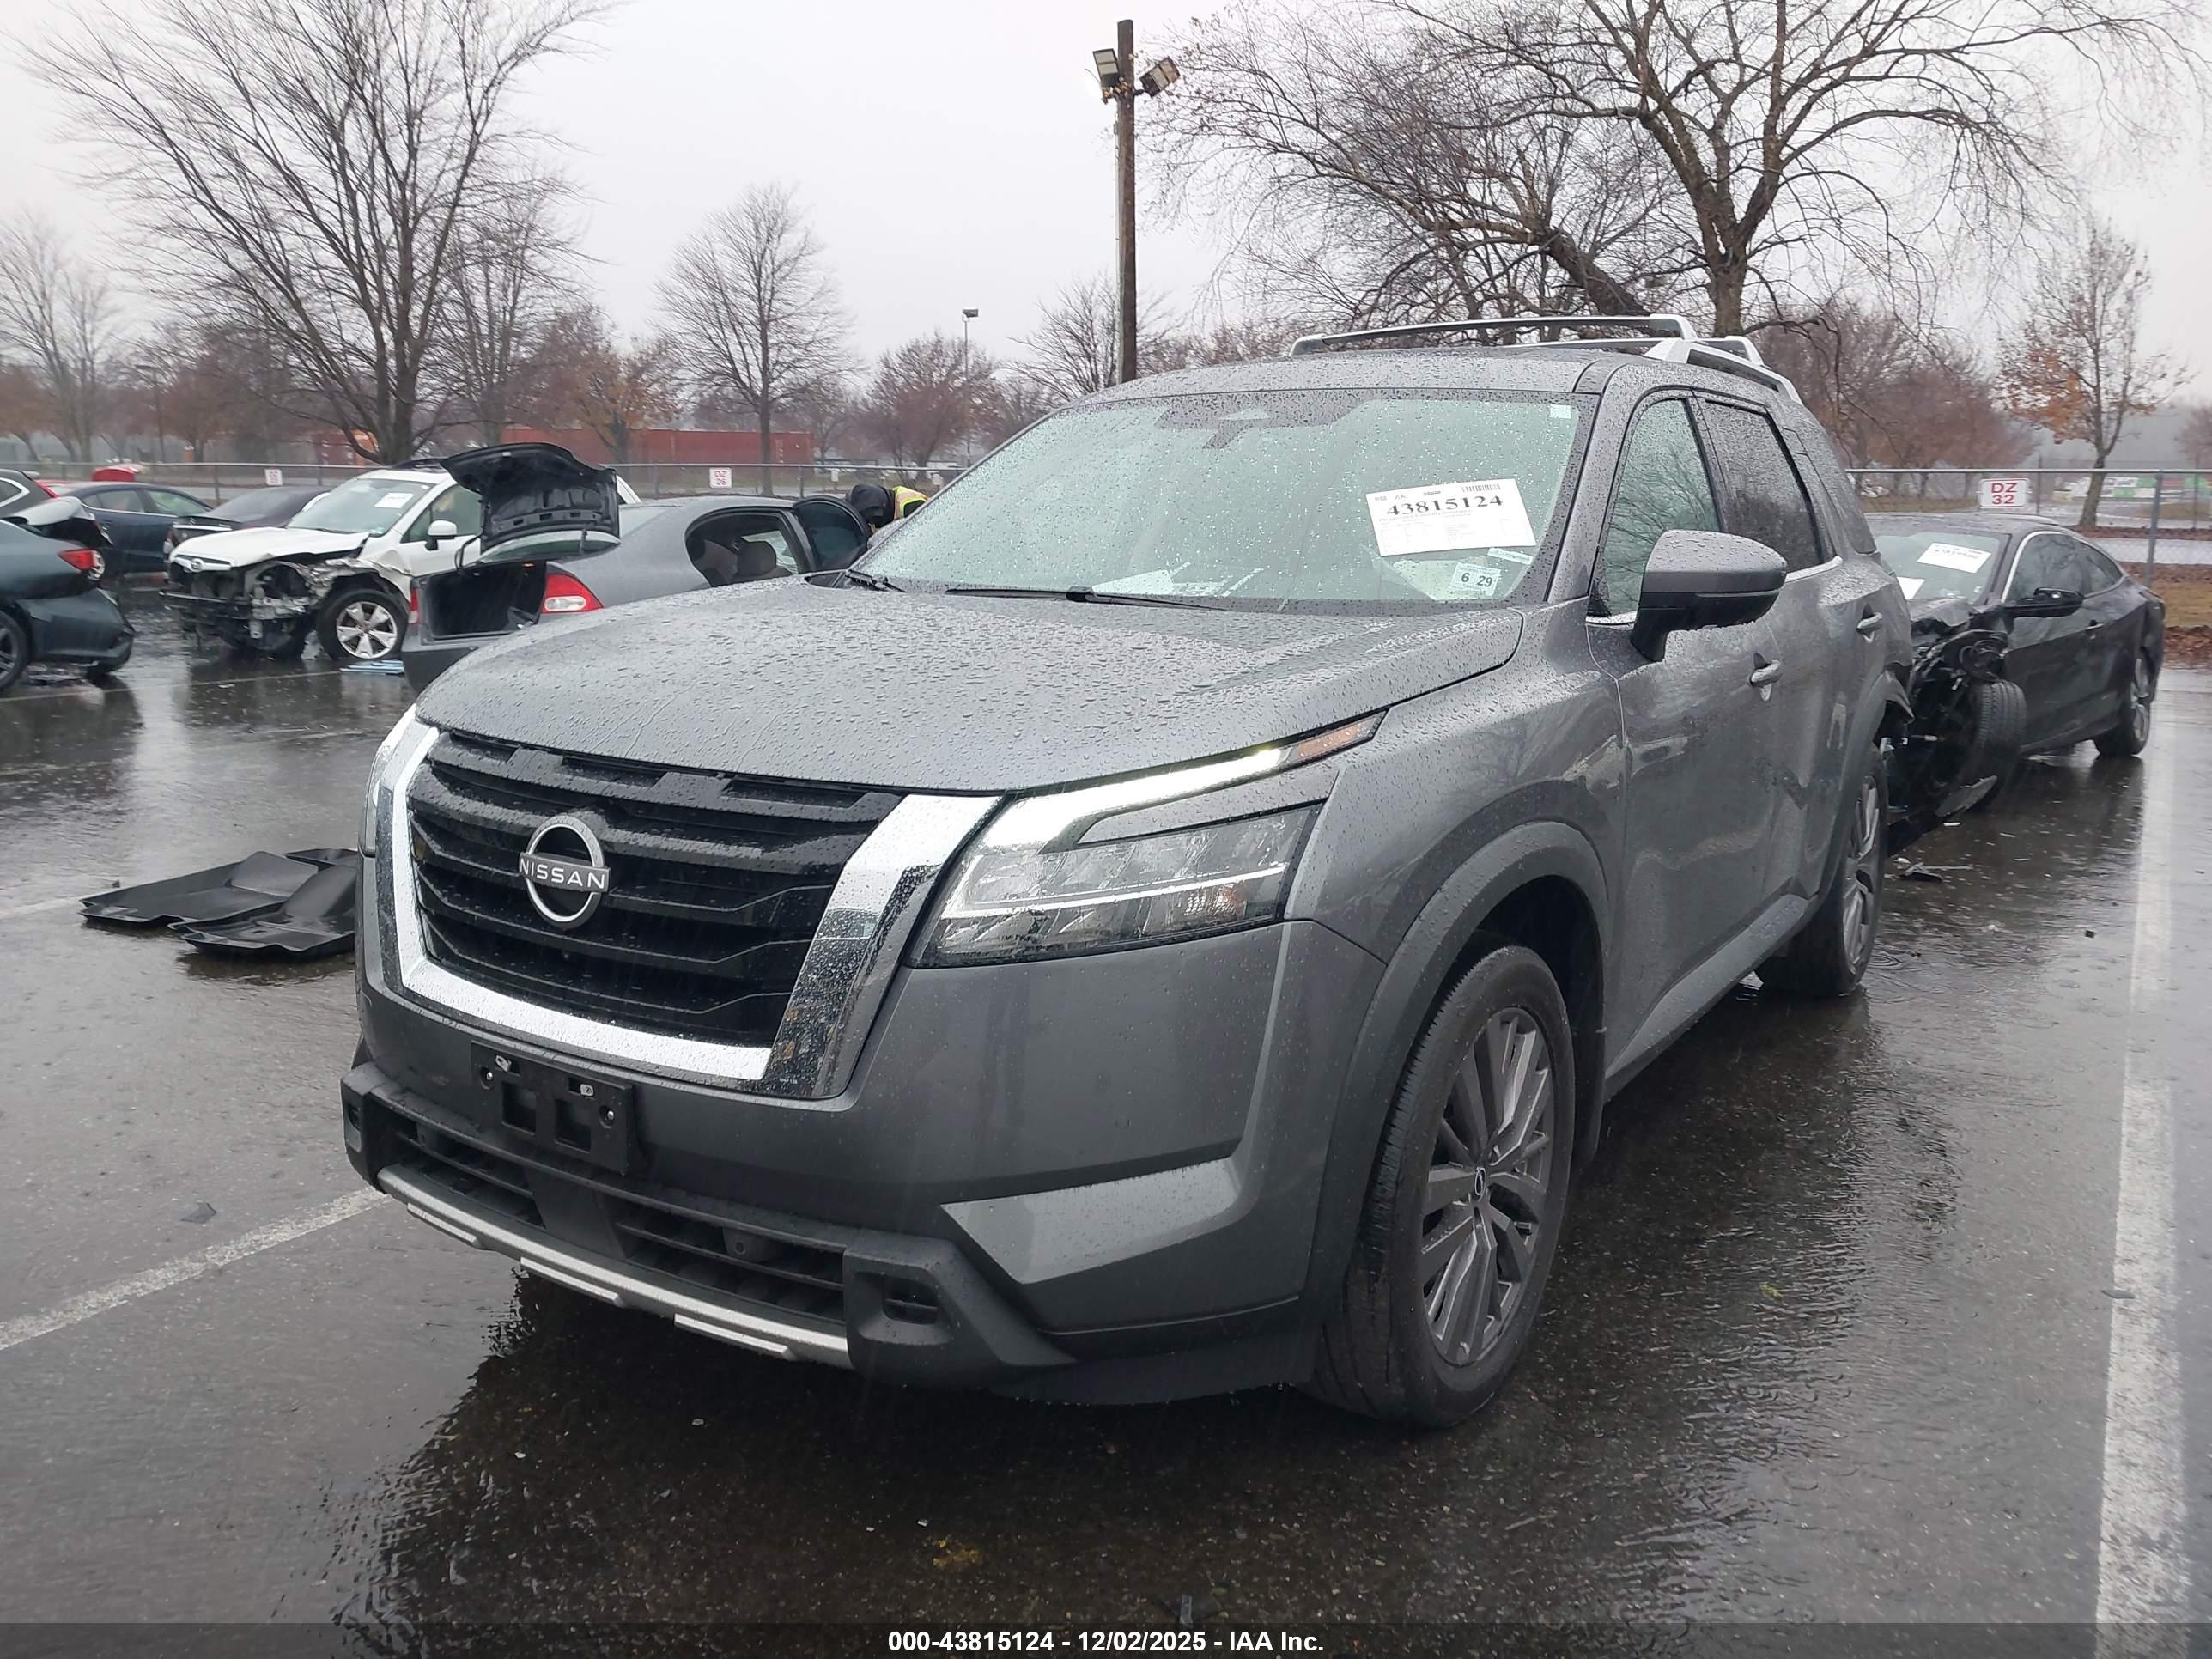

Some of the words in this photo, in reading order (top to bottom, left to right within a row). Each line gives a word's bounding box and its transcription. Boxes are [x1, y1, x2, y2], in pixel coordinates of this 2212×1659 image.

[1991, 483, 2017, 493] DZ
[1387, 495, 1504, 516] 43815124
[1992, 494, 2014, 505] 32
[1462, 572, 1470, 582] 6
[1476, 575, 1493, 587] 29
[520, 858, 605, 889] NISSAN
